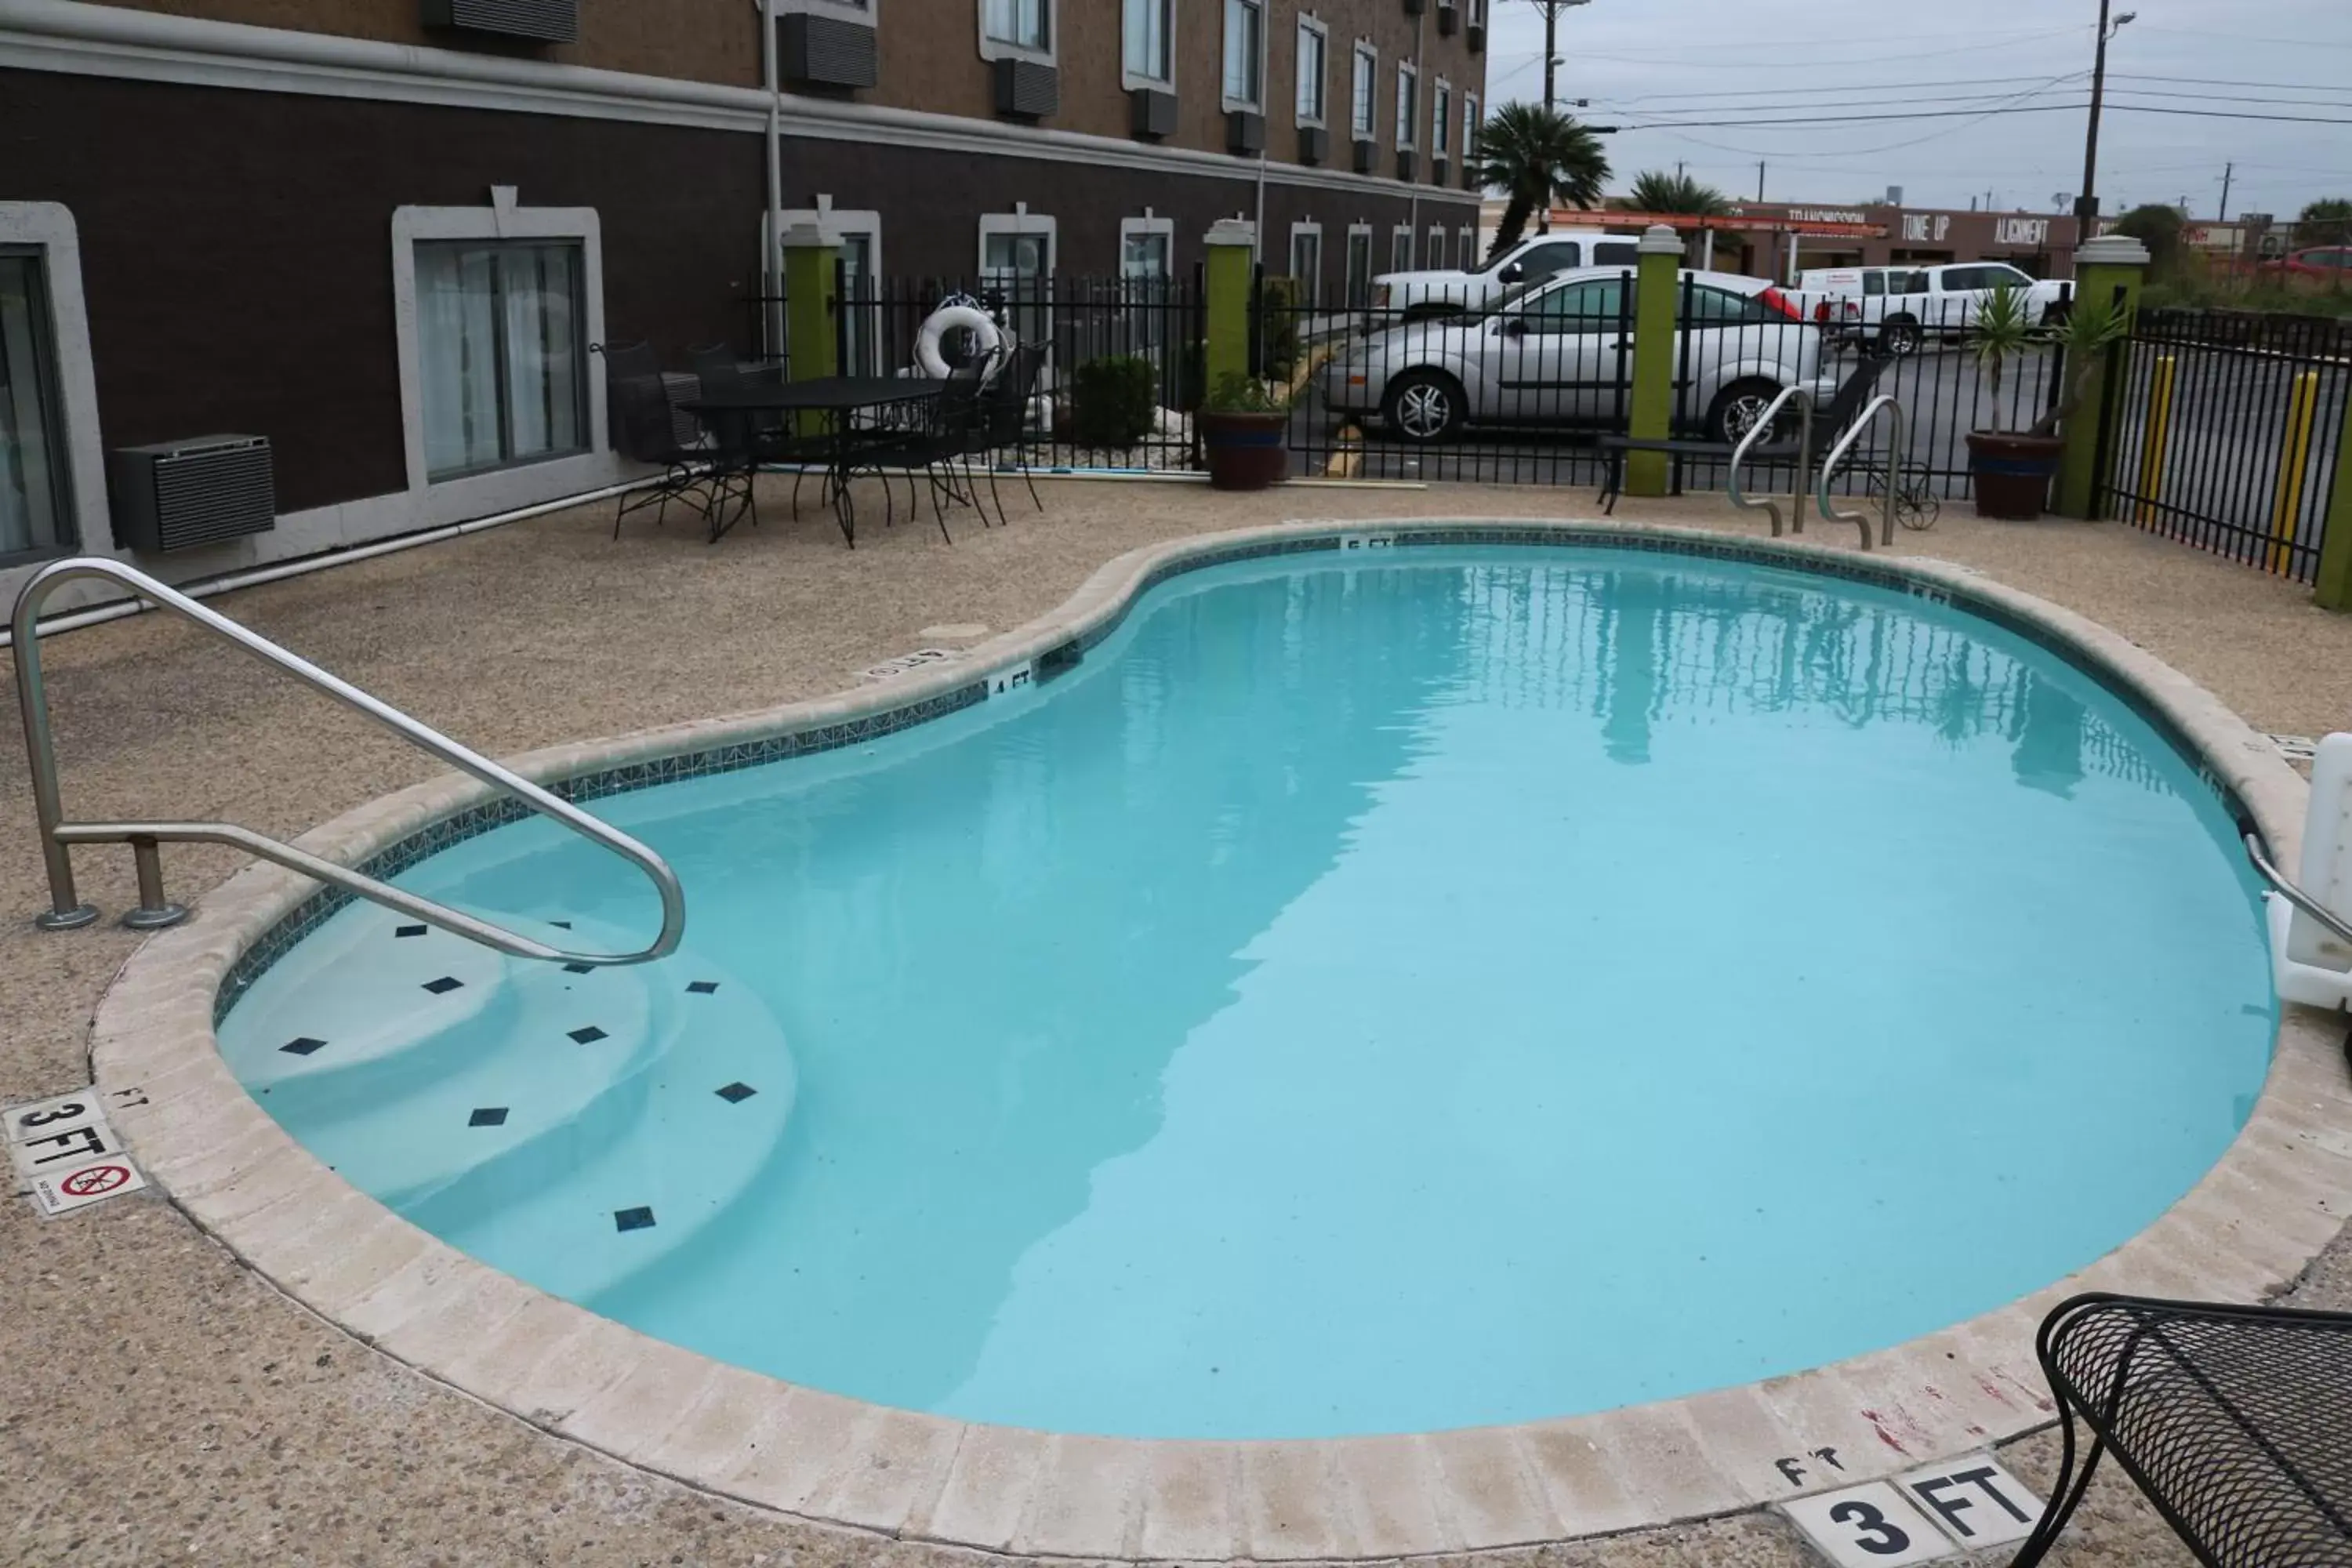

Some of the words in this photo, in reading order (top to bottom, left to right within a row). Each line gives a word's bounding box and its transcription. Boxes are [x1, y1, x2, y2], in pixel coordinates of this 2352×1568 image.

[1903, 214, 1930, 241] TUNE
[1934, 215, 1951, 241] UP
[1994, 217, 2050, 245] ALIGNMENT
[1012, 670, 1029, 689] FT
[19, 1103, 85, 1127] 3
[25, 1127, 106, 1164] FT
[1829, 1501, 1910, 1555] 3
[1911, 1466, 2033, 1537] FT
